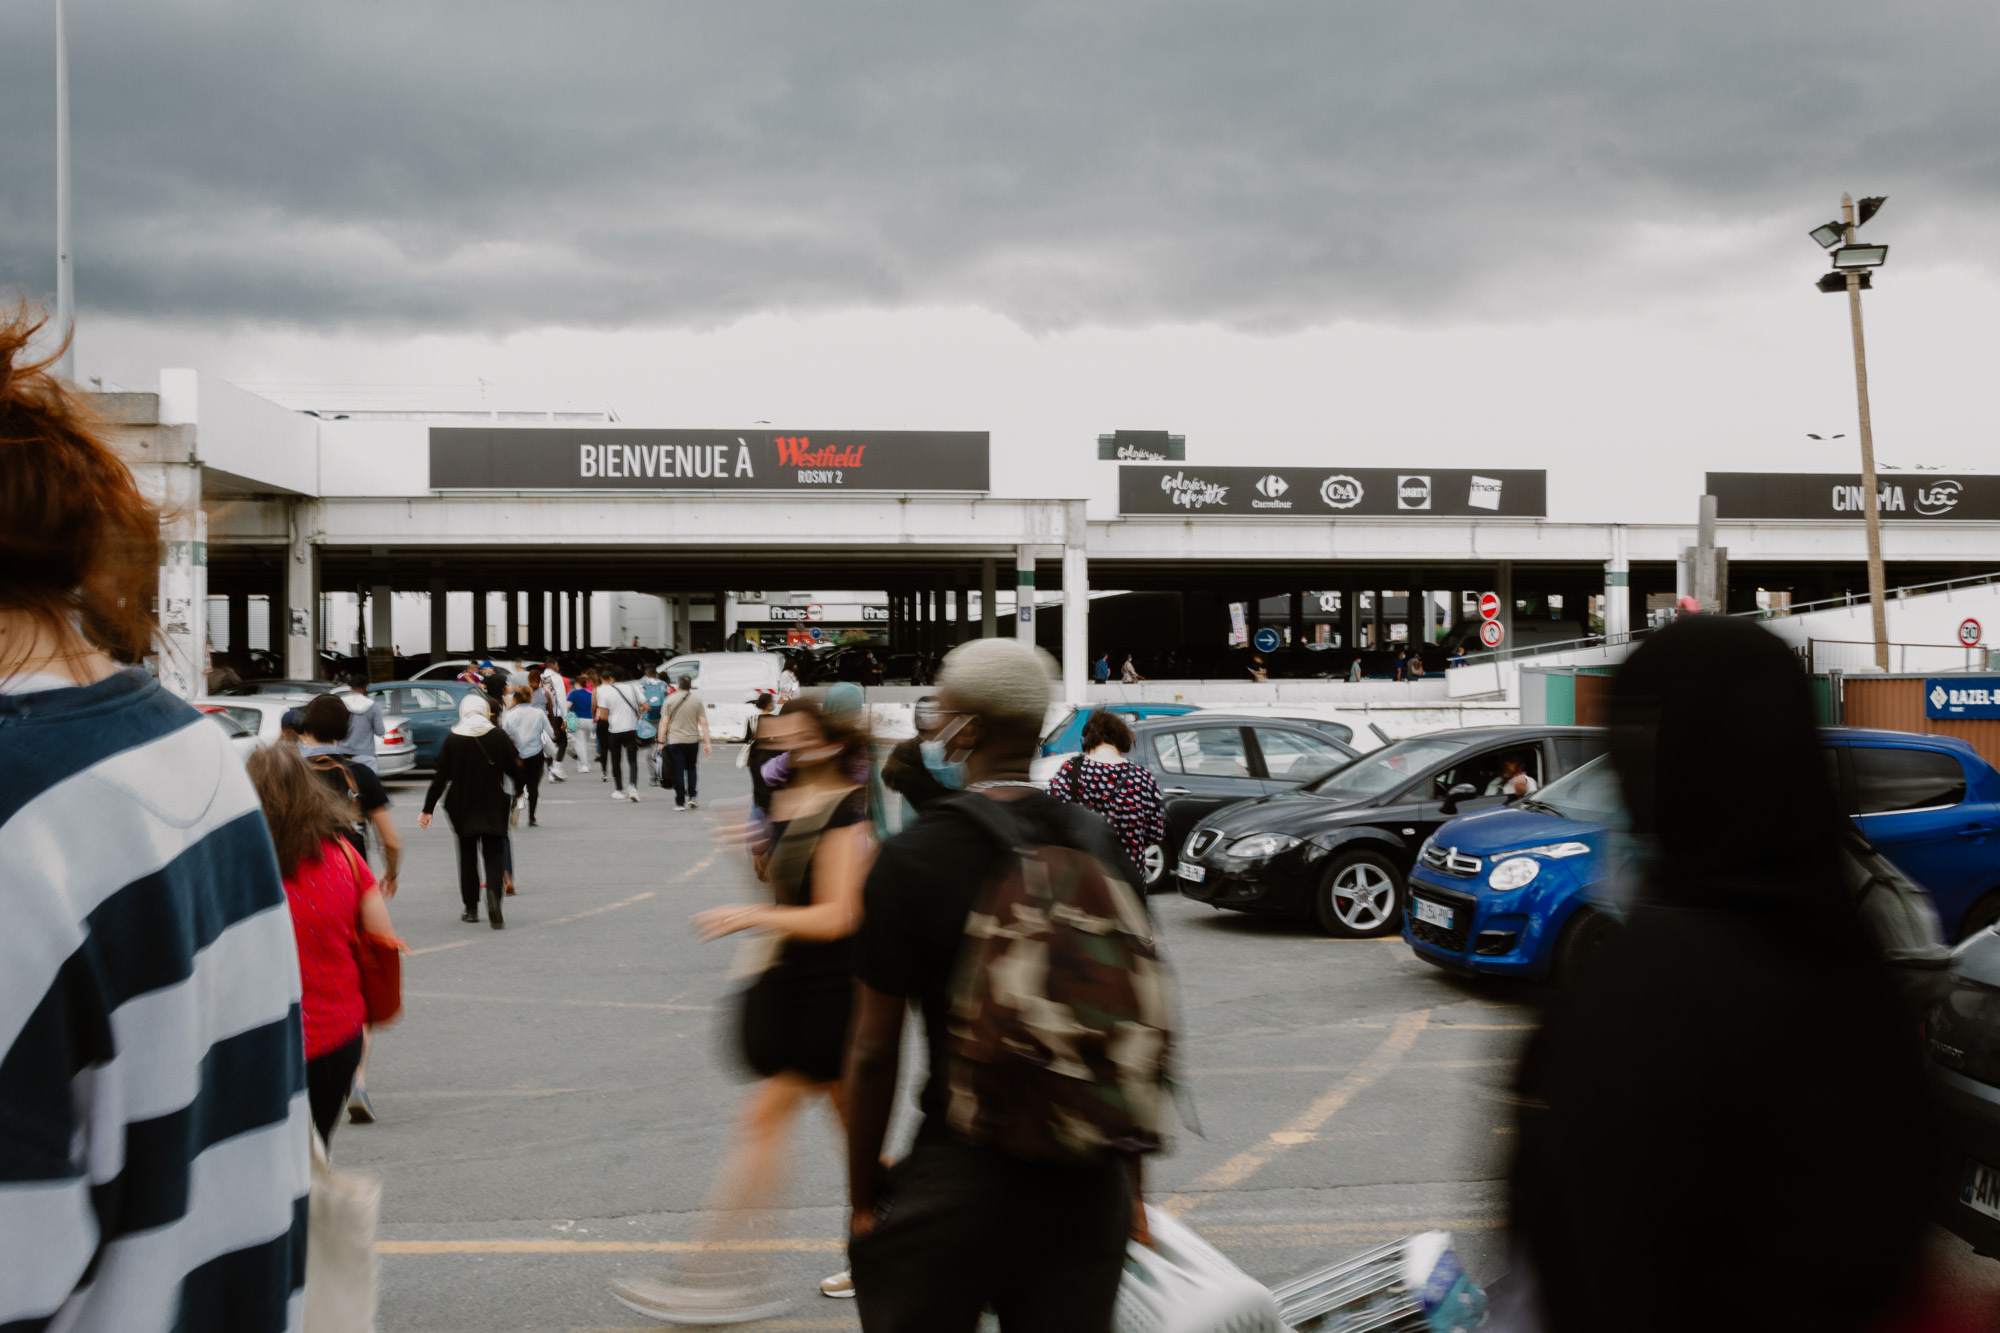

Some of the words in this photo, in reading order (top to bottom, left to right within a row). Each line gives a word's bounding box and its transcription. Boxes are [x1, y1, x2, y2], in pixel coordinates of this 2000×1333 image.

[580, 444, 729, 478] BIENVENUE
[734, 437, 754, 478] À
[774, 437, 867, 468] Westfield
[798, 469, 834, 484] ROSNY
[835, 470, 843, 484] 2
[1161, 471, 1207, 494] Galeries
[1327, 484, 1356, 500] C&A
[1400, 487, 1428, 498] DARTY
[1471, 482, 1502, 492] fnac
[1173, 483, 1230, 509] Lafayette
[1252, 499, 1293, 508] Carrefour
[1832, 485, 1906, 512] CINMA
[1918, 487, 1959, 506] UGC
[771, 606, 807, 619] fnac
[863, 606, 889, 619] fna
[1962, 626, 1979, 639] 30
